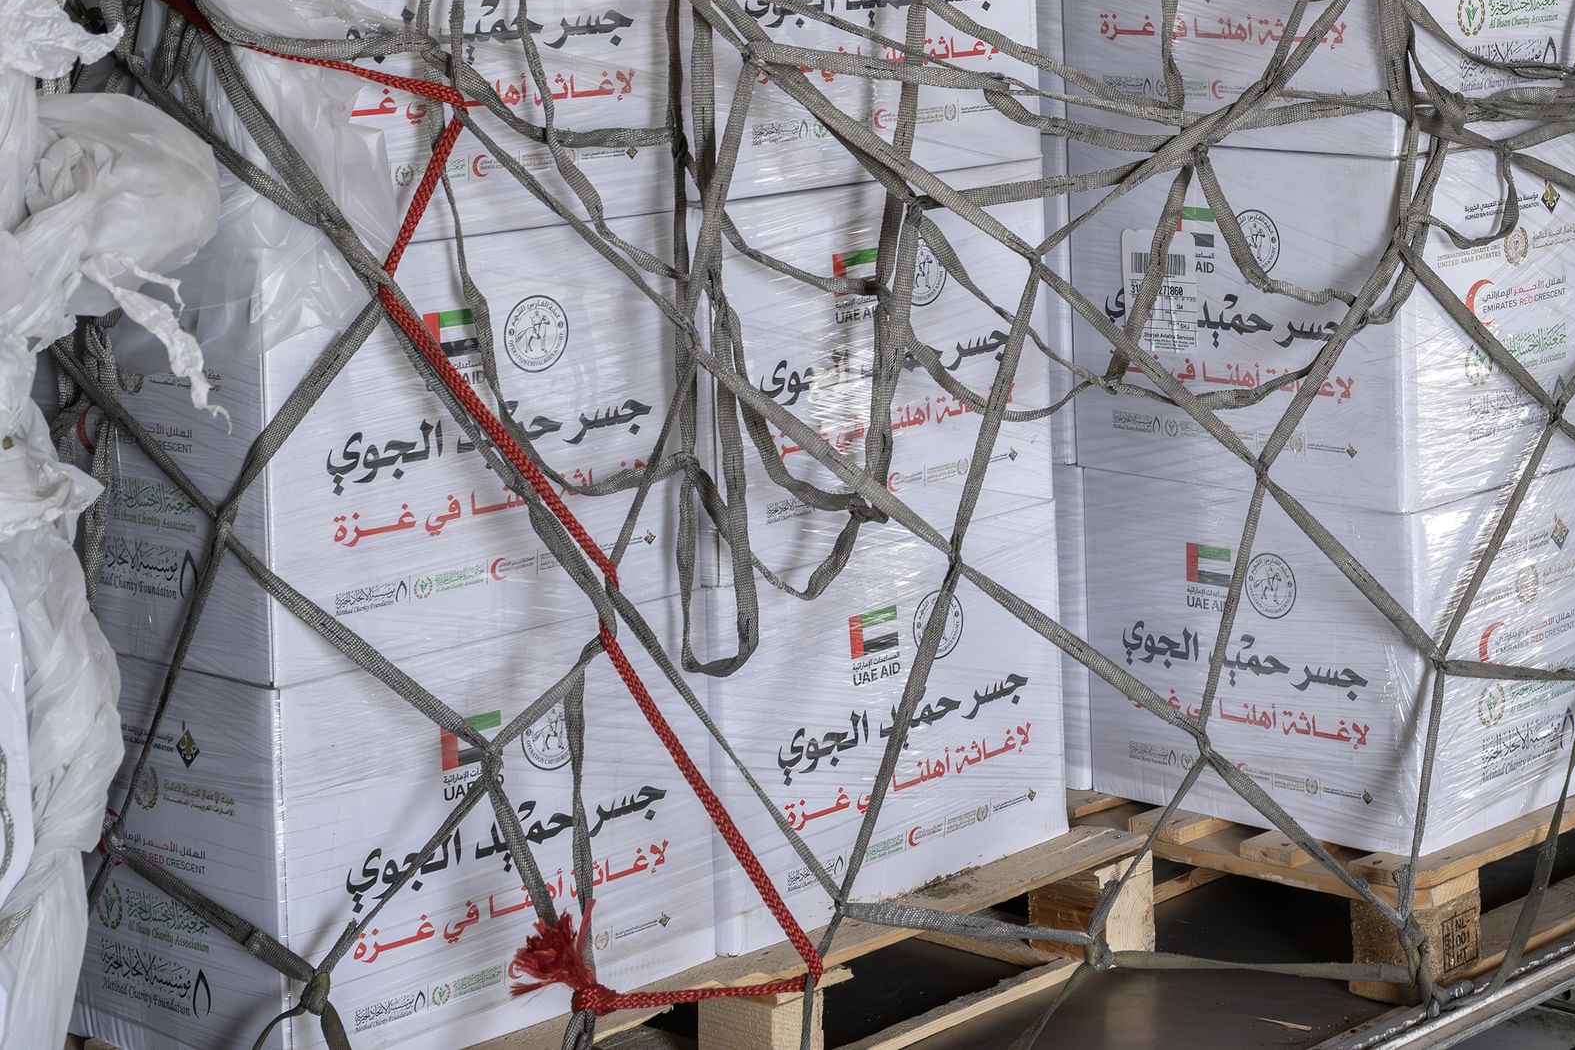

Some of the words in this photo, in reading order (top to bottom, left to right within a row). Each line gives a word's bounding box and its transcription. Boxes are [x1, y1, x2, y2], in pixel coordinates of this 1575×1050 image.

[543, 9, 635, 49] جسر
[1100, 13, 1156, 42] غزة
[1194, 15, 1253, 42] أهلنا
[1195, 261, 1214, 273] AID
[1545, 276, 1567, 289] الهلال
[1482, 287, 1512, 303] الإماراتي
[1482, 299, 1518, 314] EMIRATES
[1519, 296, 1533, 306] RED
[1534, 288, 1567, 302] CRESCENT
[1513, 280, 1544, 295] الأحمر
[1203, 360, 1260, 388] أهلنا
[561, 399, 652, 444] جسر
[890, 395, 930, 431] أهلن
[326, 418, 444, 496] الجوي
[332, 503, 416, 548] غزة
[425, 495, 462, 537] في
[113, 577, 138, 597] Charity
[139, 579, 177, 600] Foundation
[1187, 595, 1210, 609] UAE
[1544, 621, 1575, 638] CRESCENT
[1556, 609, 1575, 624] الهلال
[1122, 619, 1198, 669] الجوي
[853, 670, 879, 686] UAE
[880, 662, 901, 679] AID
[1290, 662, 1368, 701] جسر
[961, 673, 1029, 719] جسر
[1219, 697, 1277, 731] أهلنا
[1282, 709, 1371, 750] لإغاثة
[777, 709, 869, 786] الجوي
[955, 721, 1032, 774] لإغاثة
[892, 752, 950, 792] أهلنا
[590, 784, 667, 837] جسر
[784, 787, 851, 832] غزة
[142, 837, 178, 853] الأحمر
[179, 845, 206, 860] الهلال
[149, 853, 166, 866] RED
[166, 858, 206, 875] CRESCENT
[345, 828, 462, 913] الجوي
[152, 926, 174, 948] Charity
[175, 931, 210, 953] Association
[353, 913, 436, 963] غزة
[442, 900, 480, 944] في
[128, 982, 153, 1009] Charity
[153, 991, 190, 1017] Foundation
